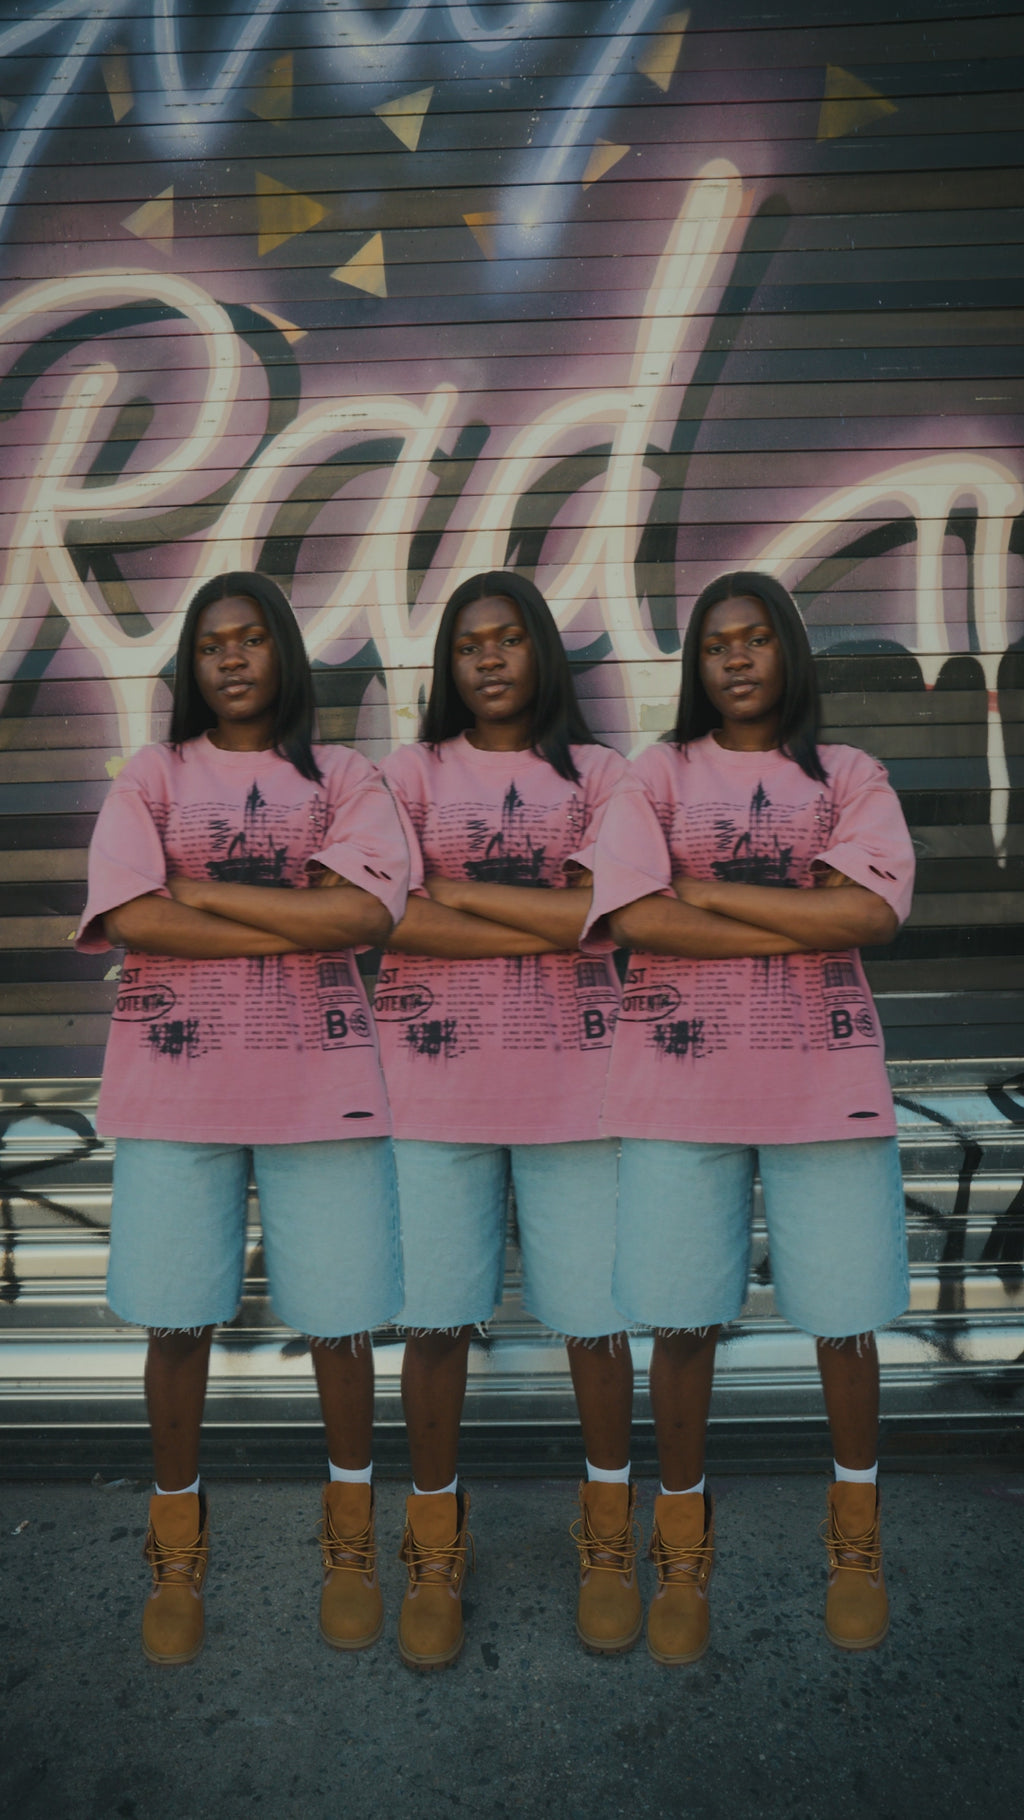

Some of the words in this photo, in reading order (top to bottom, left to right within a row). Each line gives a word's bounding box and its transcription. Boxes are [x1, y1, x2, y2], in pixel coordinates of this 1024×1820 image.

[326, 1009, 348, 1039] B
[583, 1009, 606, 1039] B
[831, 1009, 853, 1039] B
